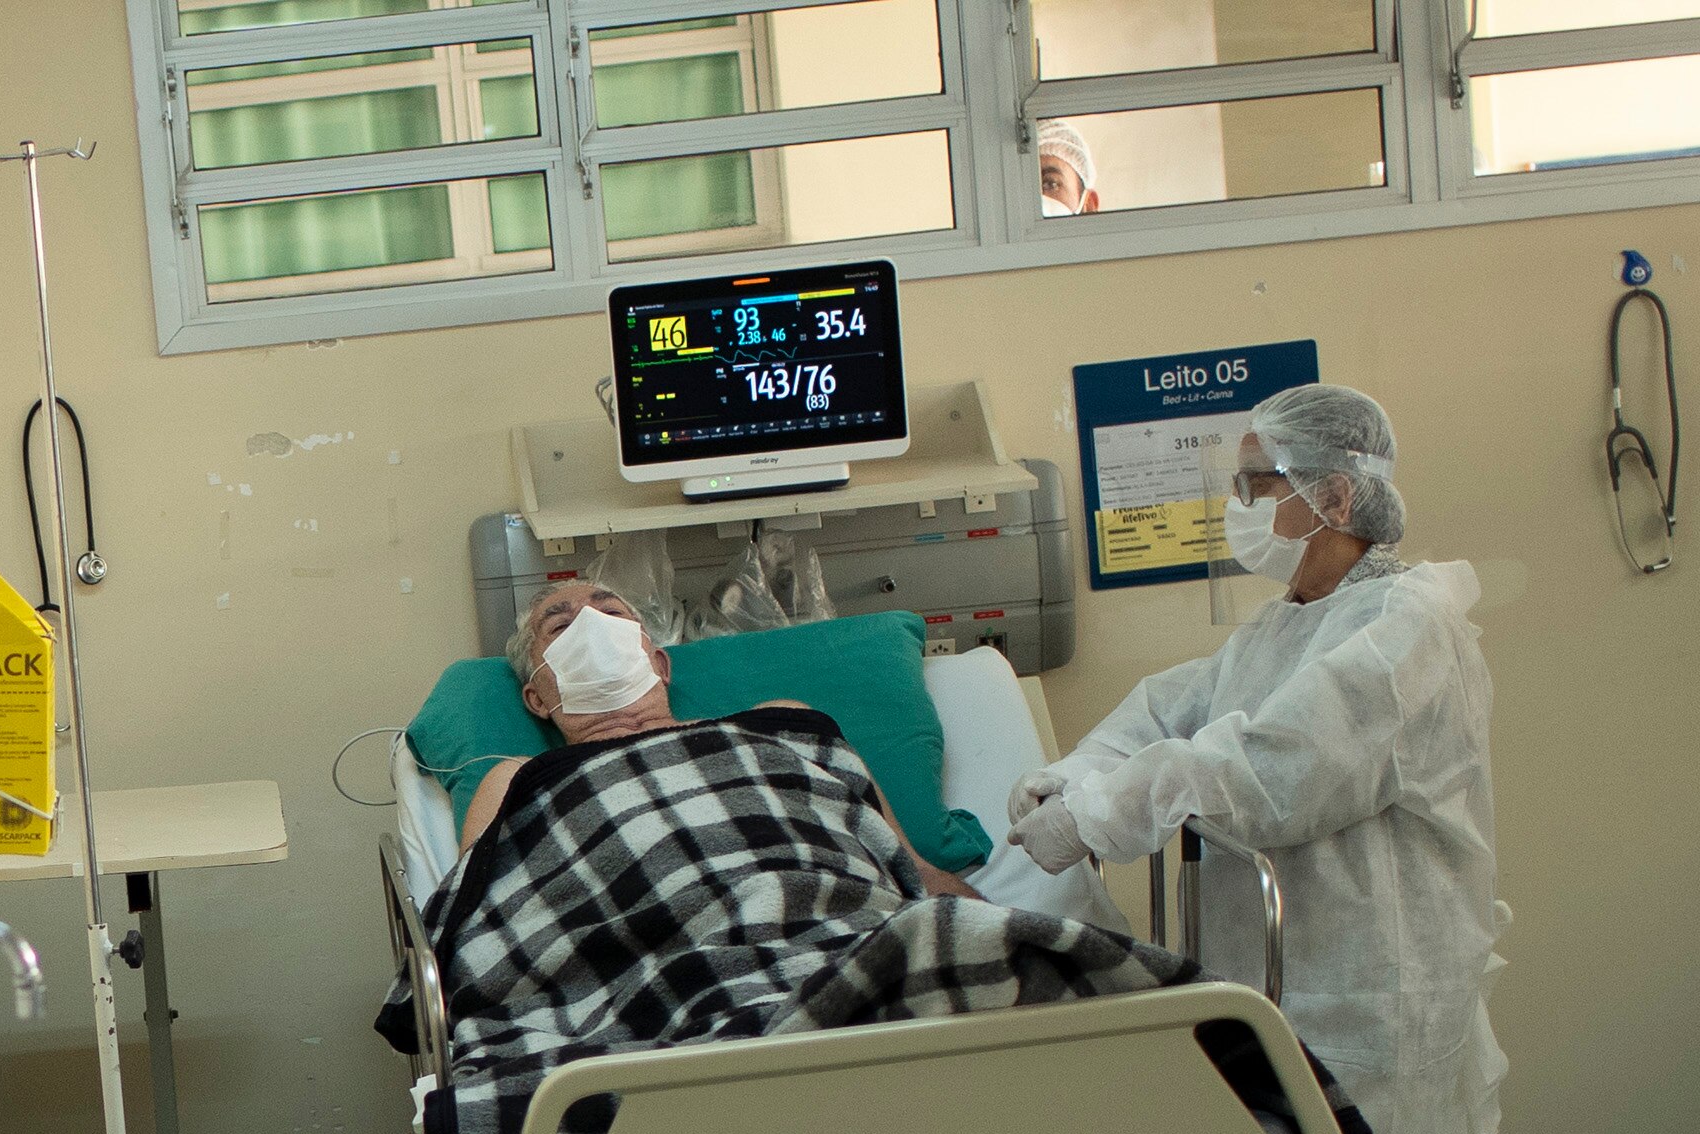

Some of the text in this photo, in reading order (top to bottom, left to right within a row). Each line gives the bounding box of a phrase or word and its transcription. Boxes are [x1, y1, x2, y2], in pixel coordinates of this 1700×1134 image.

[733, 307, 760, 331] 93
[814, 308, 866, 341] 35.4
[651, 316, 687, 350] 46
[737, 330, 762, 346] 2.38
[771, 328, 787, 343] 46
[745, 364, 837, 402] 143/76
[1143, 358, 1249, 392] Leito 05
[805, 393, 830, 412] (83)
[1162, 389, 1234, 406] Bed Lit Cama
[749, 455, 780, 466] mindray
